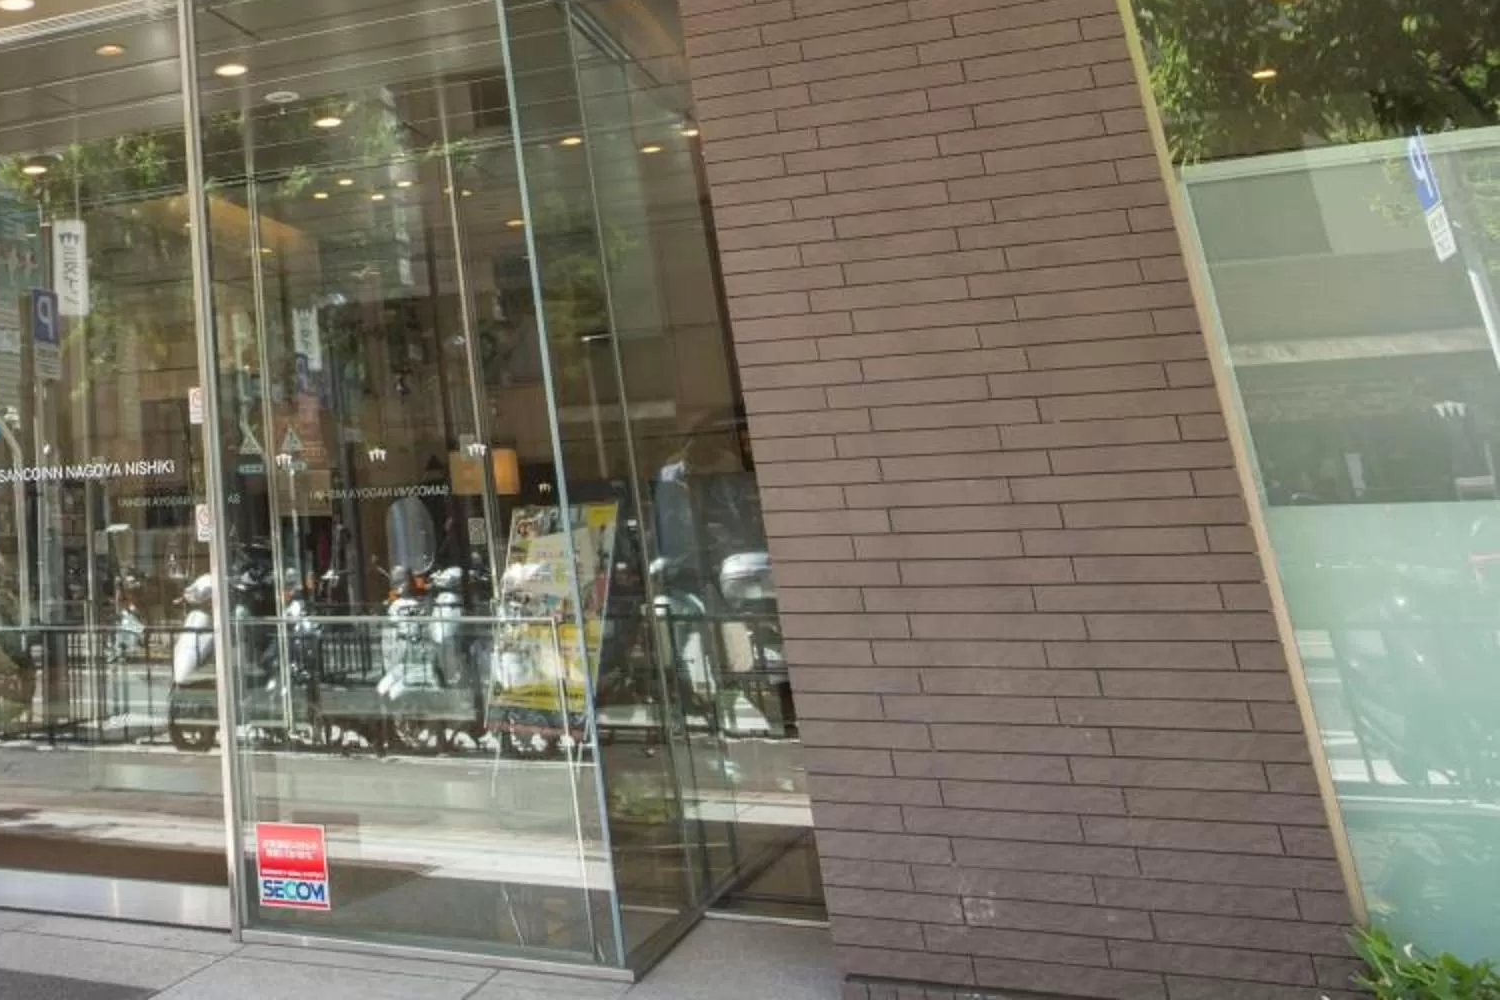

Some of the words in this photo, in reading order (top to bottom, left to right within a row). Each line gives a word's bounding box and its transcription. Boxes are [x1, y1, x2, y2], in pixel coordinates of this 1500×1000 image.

[65, 462, 122, 480] NAGOYA
[125, 459, 176, 476] NISHIKI
[263, 880, 325, 901] SECOM
